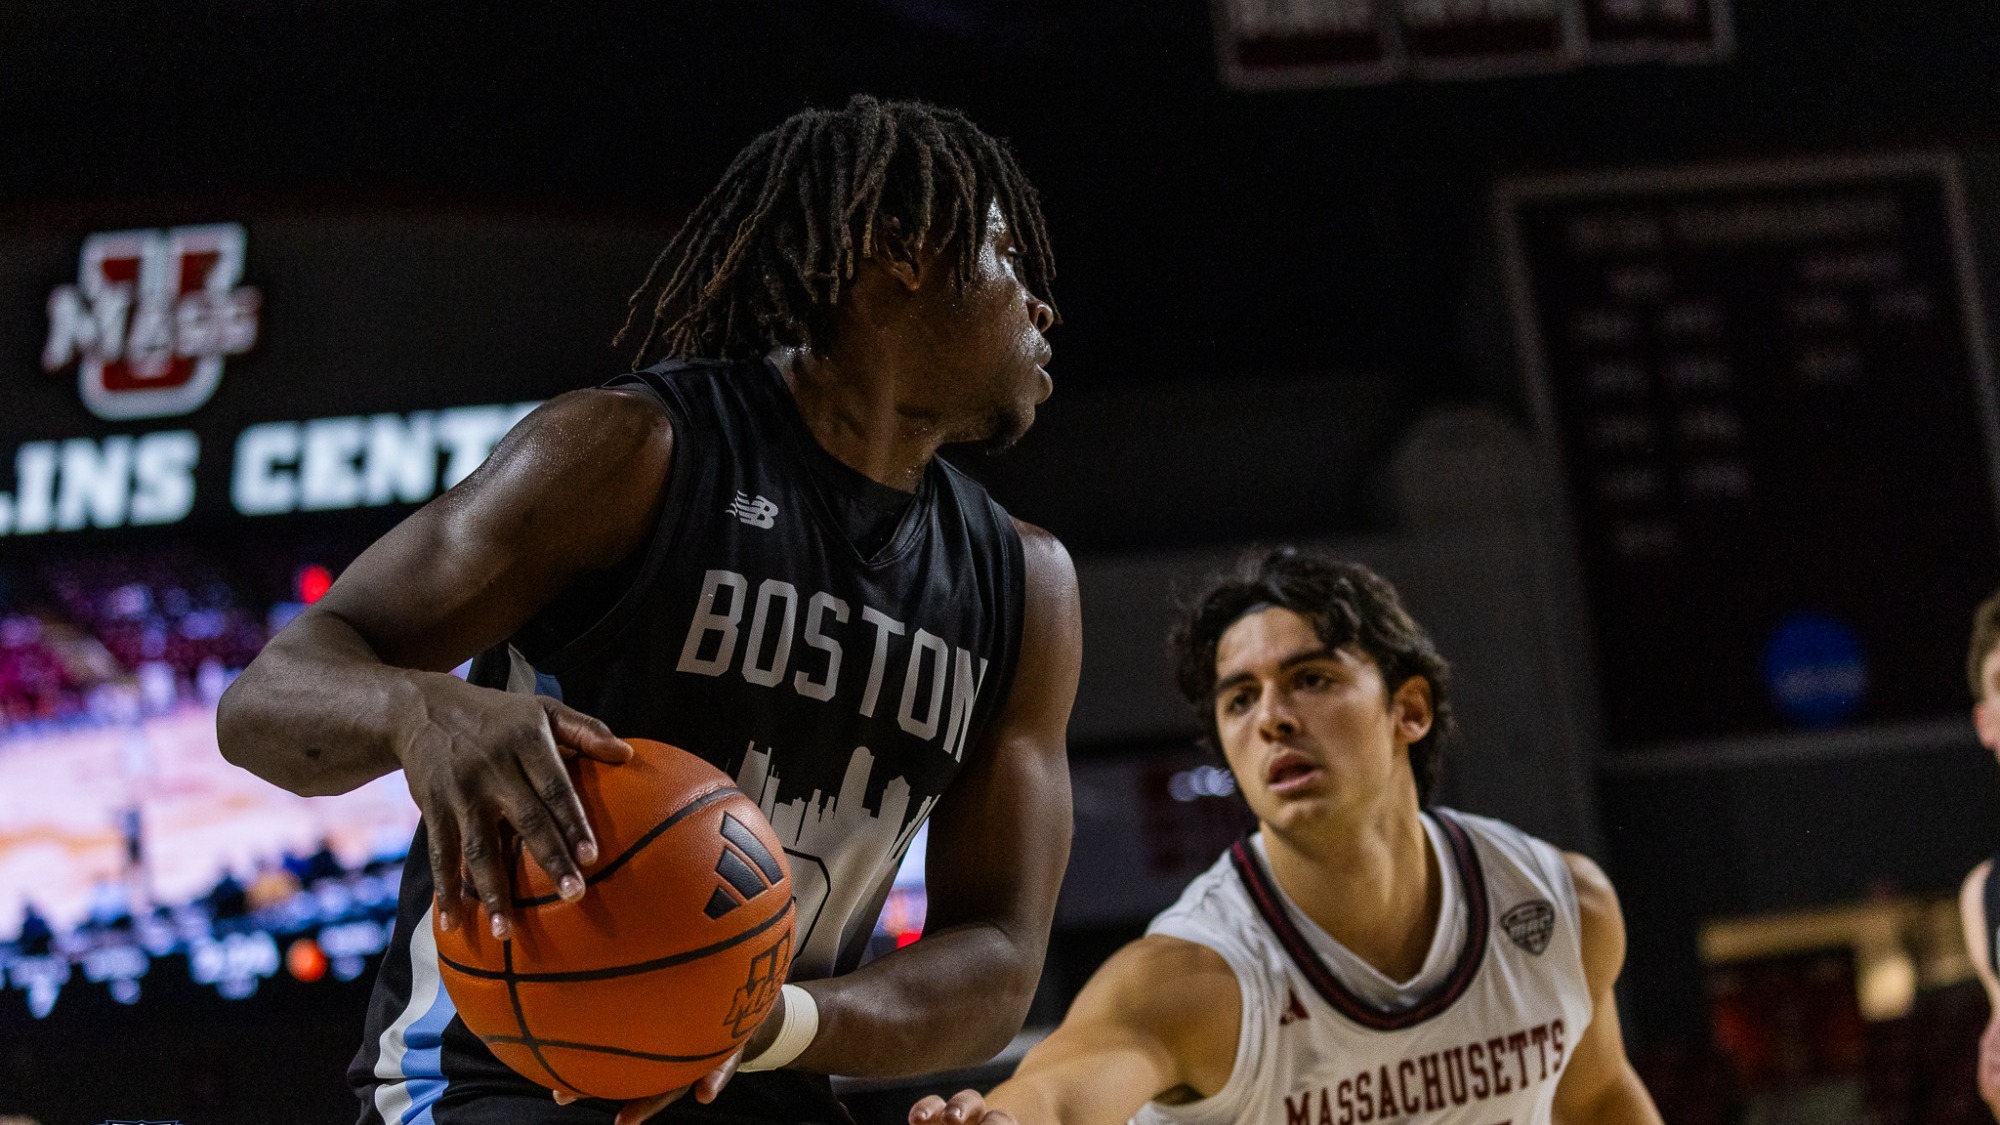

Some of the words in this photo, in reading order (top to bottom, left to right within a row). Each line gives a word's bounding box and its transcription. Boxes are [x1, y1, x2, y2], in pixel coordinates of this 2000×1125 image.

[0, 429, 199, 537] INS
[229, 400, 546, 517] CENT
[675, 569, 989, 764] BOSTON
[1284, 1018, 1565, 1125] MASSACHUSETTS
